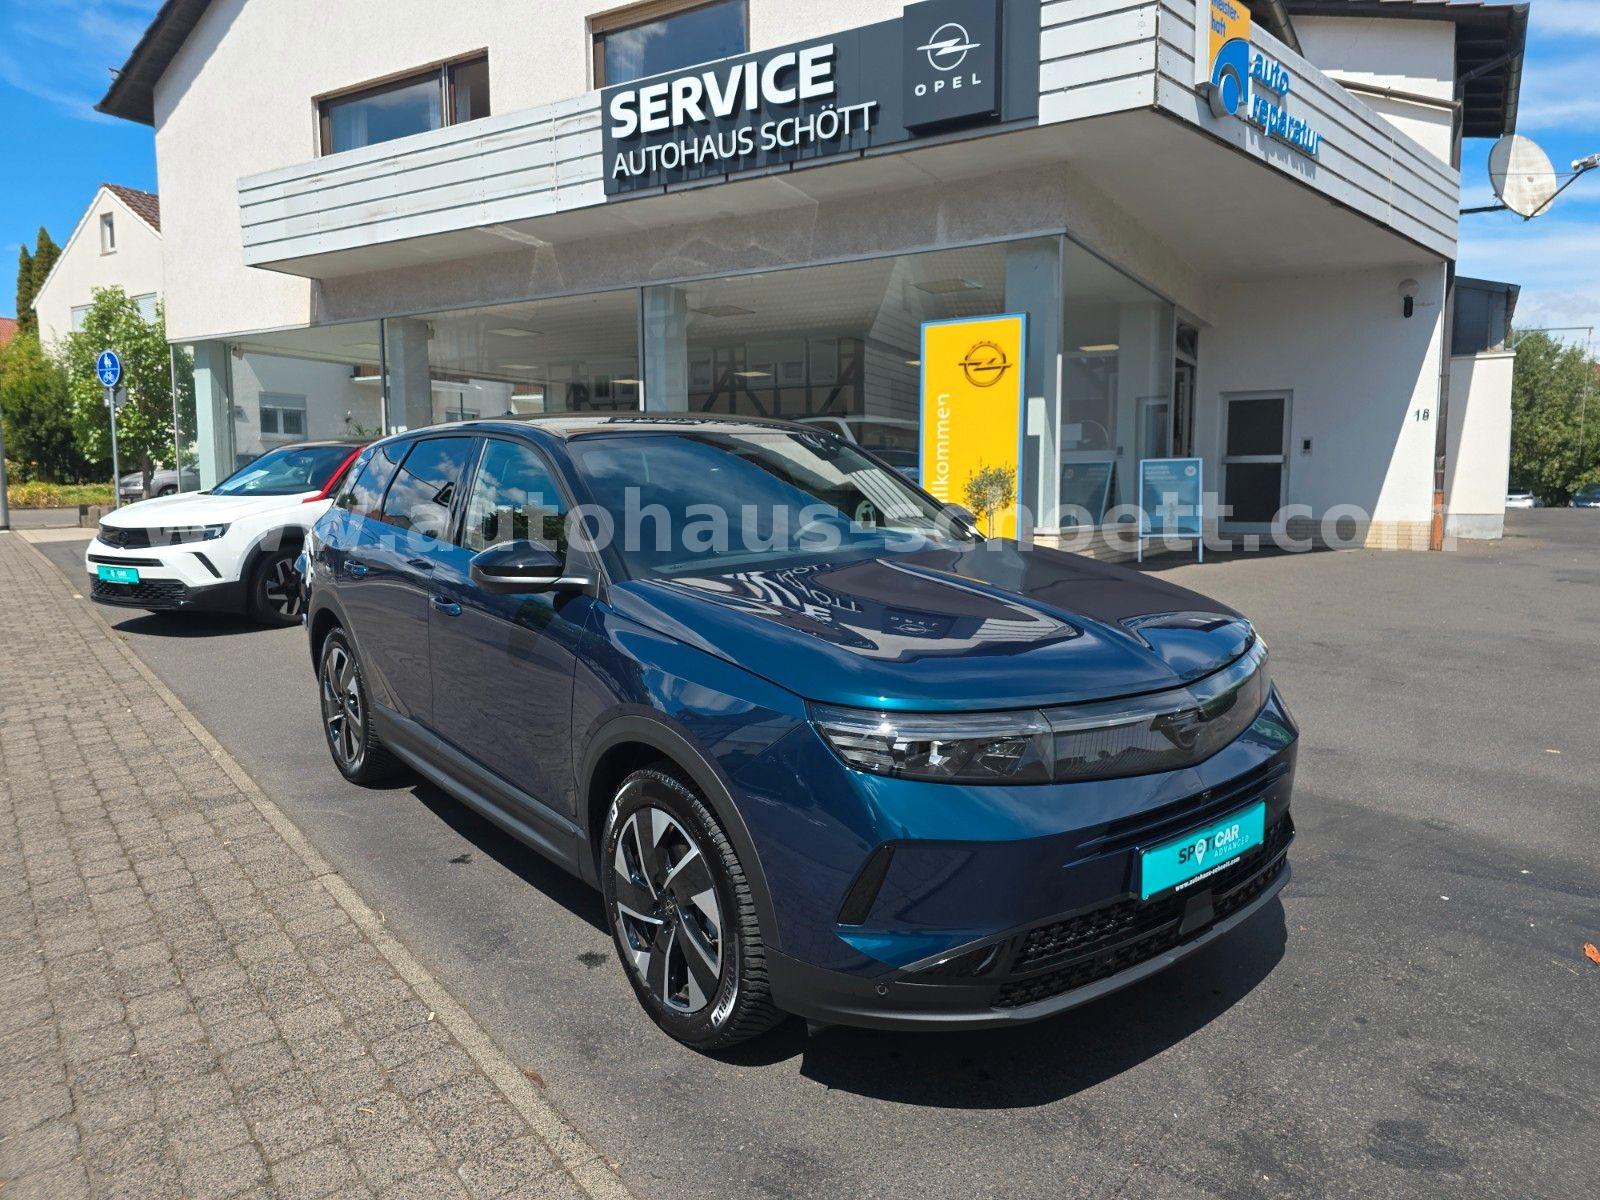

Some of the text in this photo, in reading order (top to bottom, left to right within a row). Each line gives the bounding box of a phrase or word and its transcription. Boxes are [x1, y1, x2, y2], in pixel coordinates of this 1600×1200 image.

[609, 43, 834, 138] SERVICE
[914, 73, 982, 97] OPEL
[1251, 53, 1290, 97] auto
[612, 100, 877, 179] AUTOHAUS SCHÖTT
[1251, 93, 1323, 155] reparatur
[931, 393, 951, 504] illkommen
[1214, 834, 1250, 857] ADVANCED
